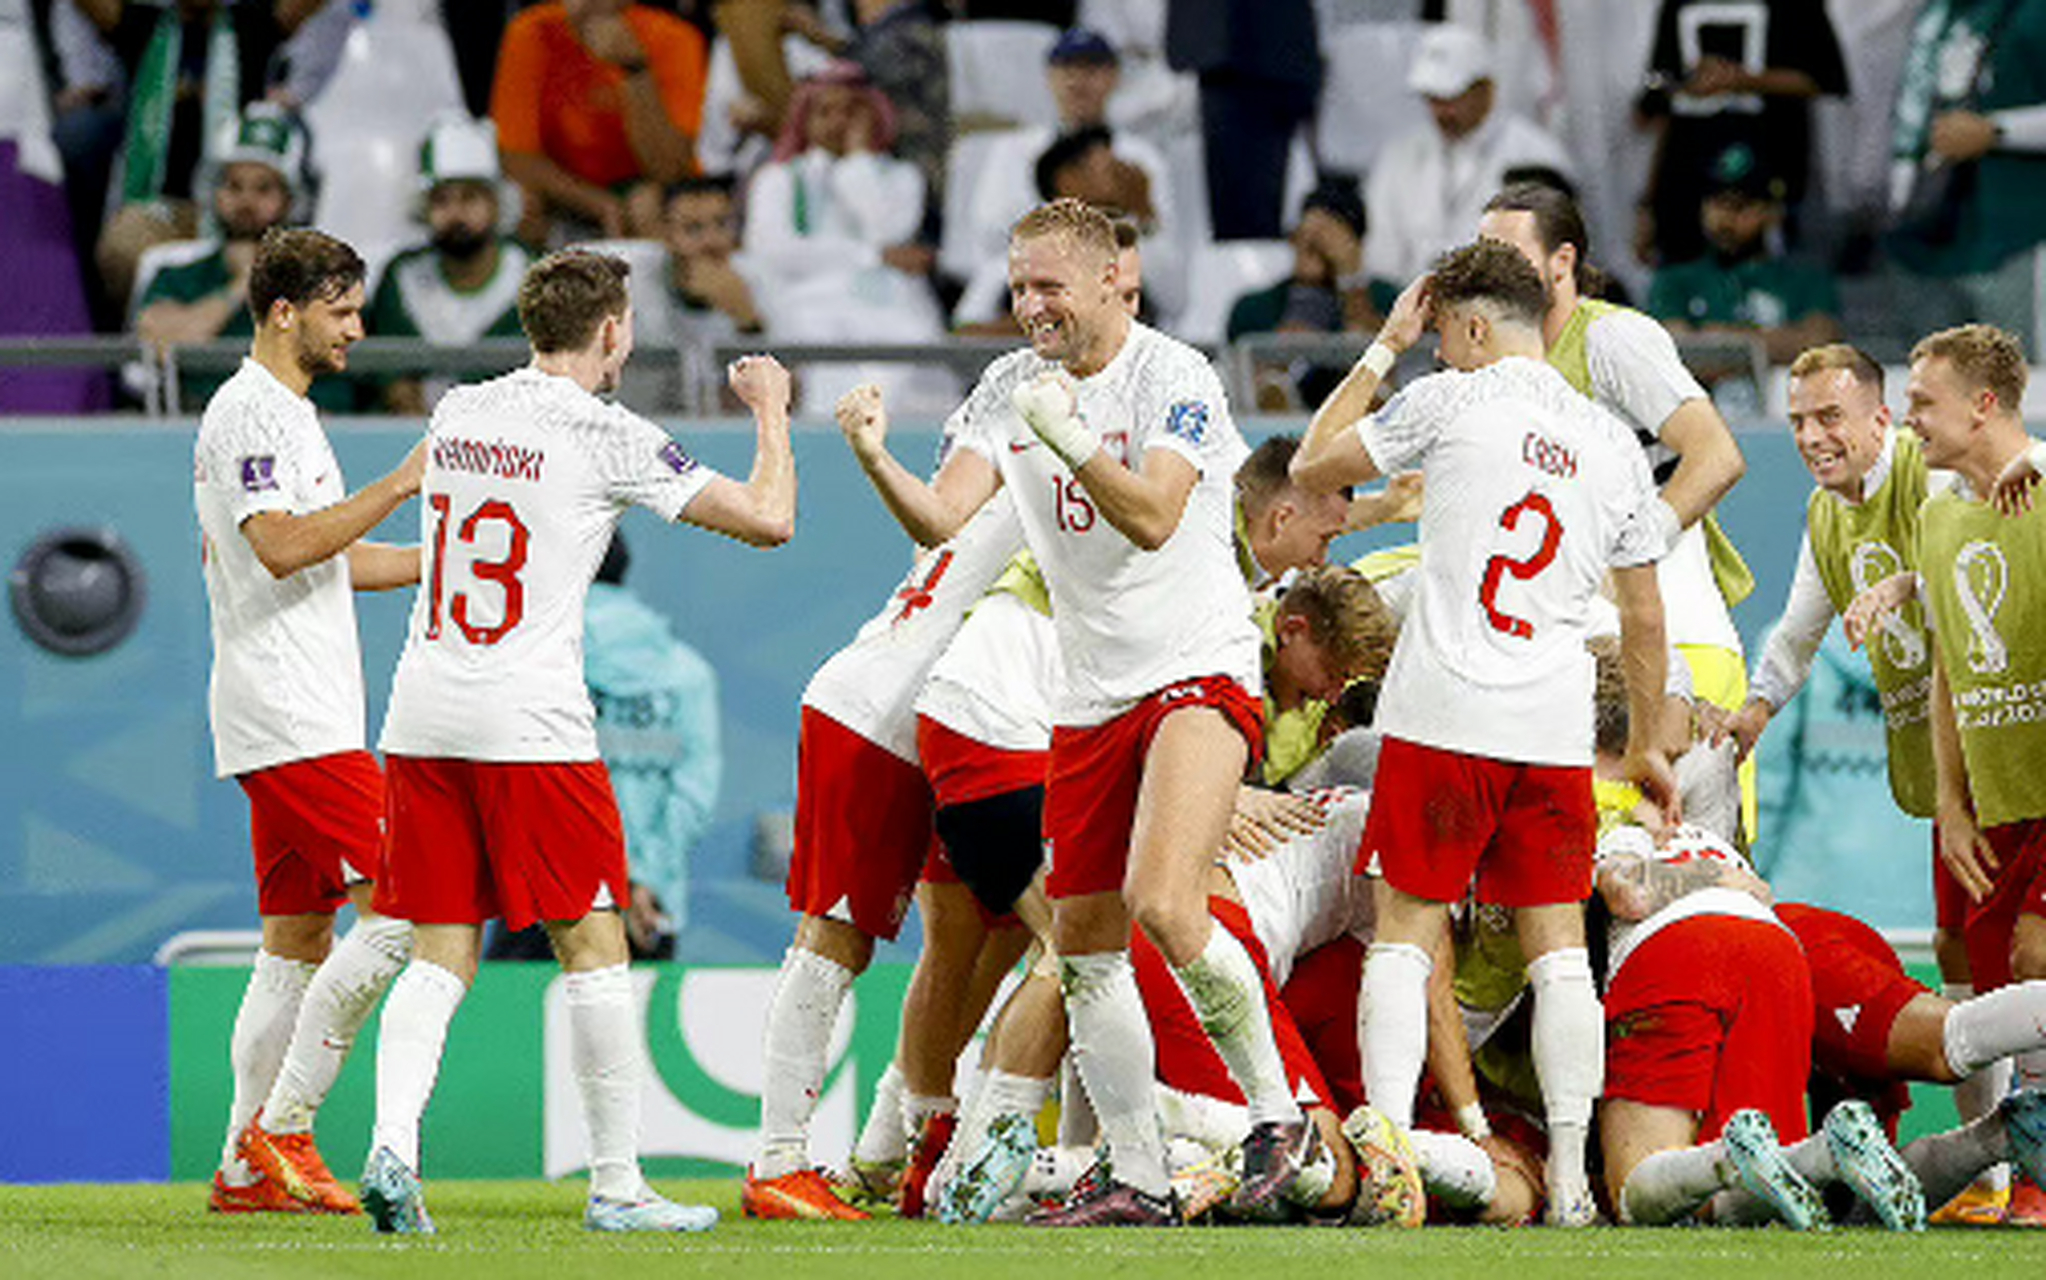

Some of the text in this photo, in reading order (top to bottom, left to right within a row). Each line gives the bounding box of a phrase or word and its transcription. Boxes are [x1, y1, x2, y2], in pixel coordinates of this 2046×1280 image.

[428, 493, 531, 645] 13
[1052, 474, 1096, 532] 15
[1480, 491, 1564, 640] 2
